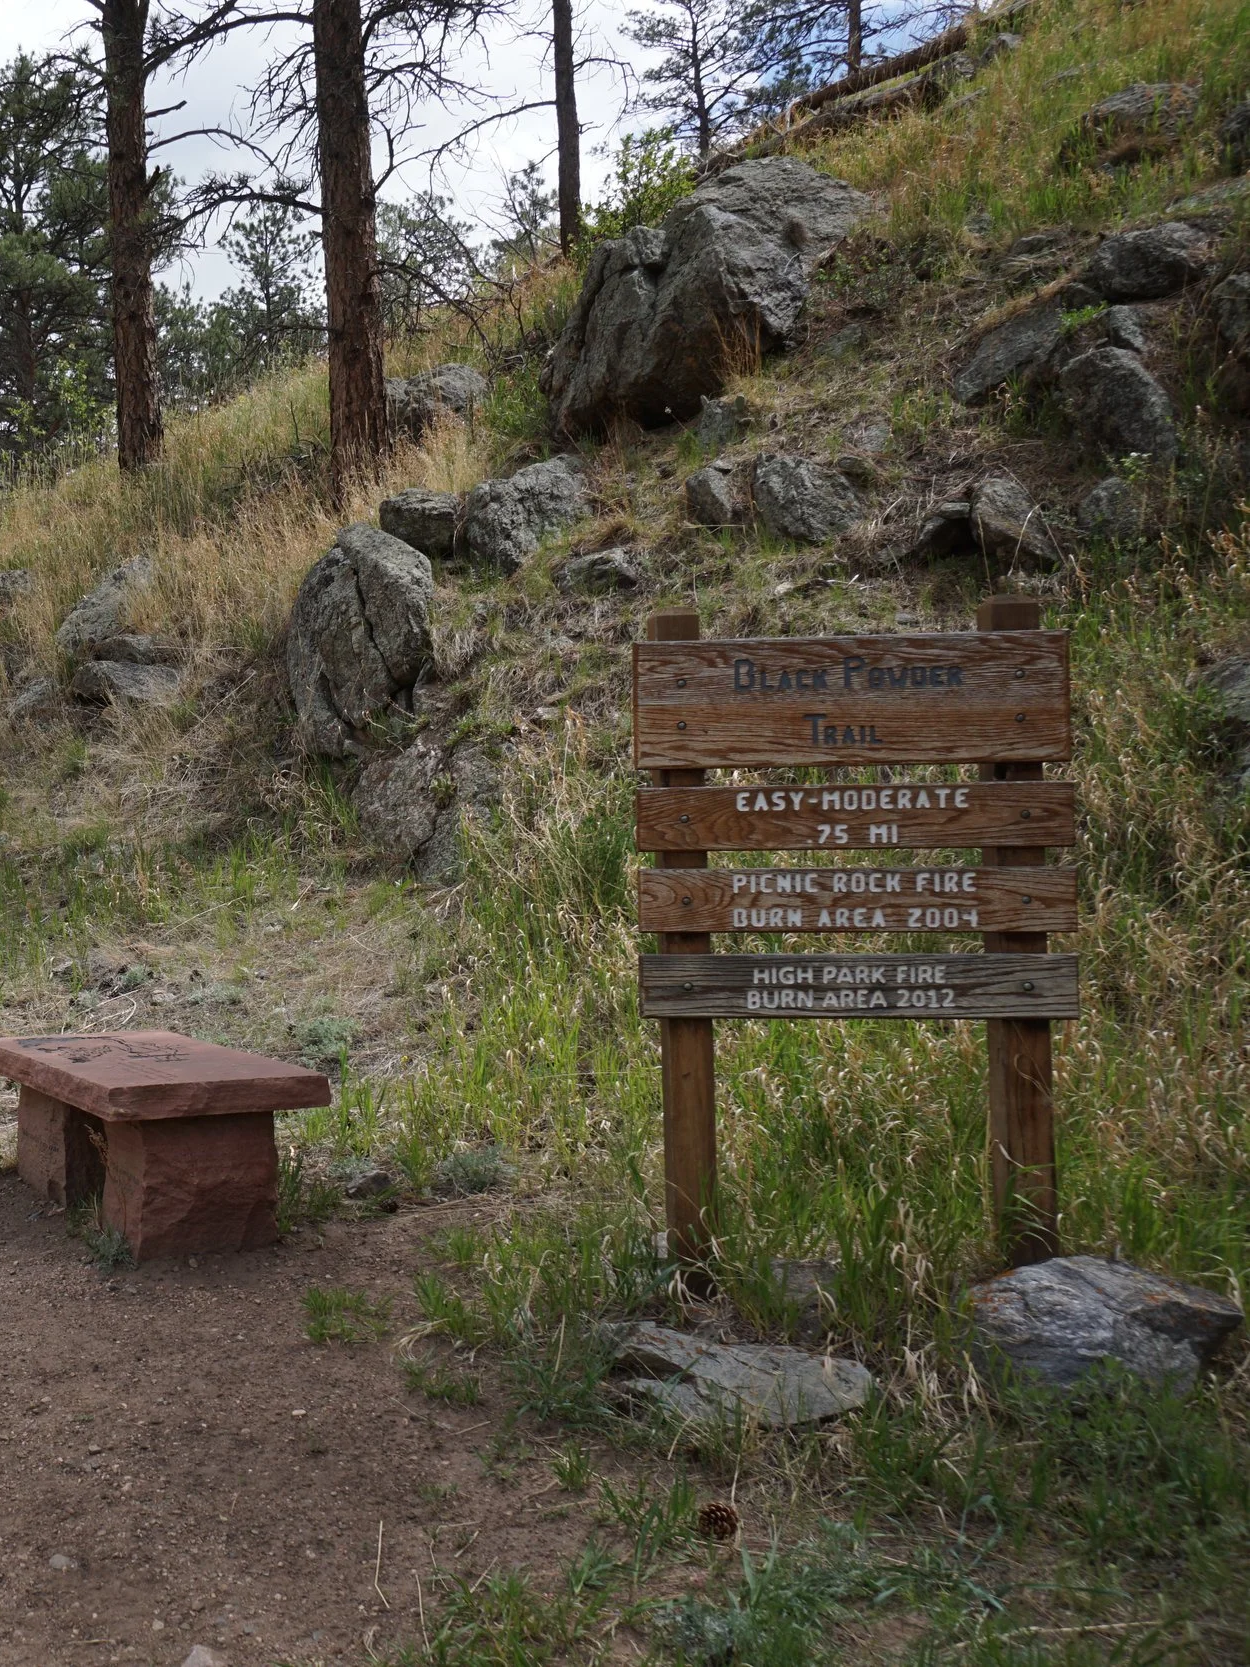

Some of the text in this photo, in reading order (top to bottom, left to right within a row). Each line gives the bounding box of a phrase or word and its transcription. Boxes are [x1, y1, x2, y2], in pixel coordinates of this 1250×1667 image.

[733, 656, 964, 692] BLACK POWDER
[802, 713, 884, 745] TRAIL
[735, 788, 971, 812] EASY-MODERATE
[806, 823, 899, 844] .75 MI
[732, 871, 978, 894] PICNIC ROCK FIRE
[732, 907, 980, 928] BURN AREA 2004
[752, 964, 947, 985] HIGH PARK FIRE
[746, 988, 956, 1009] BURN AREA 2012
